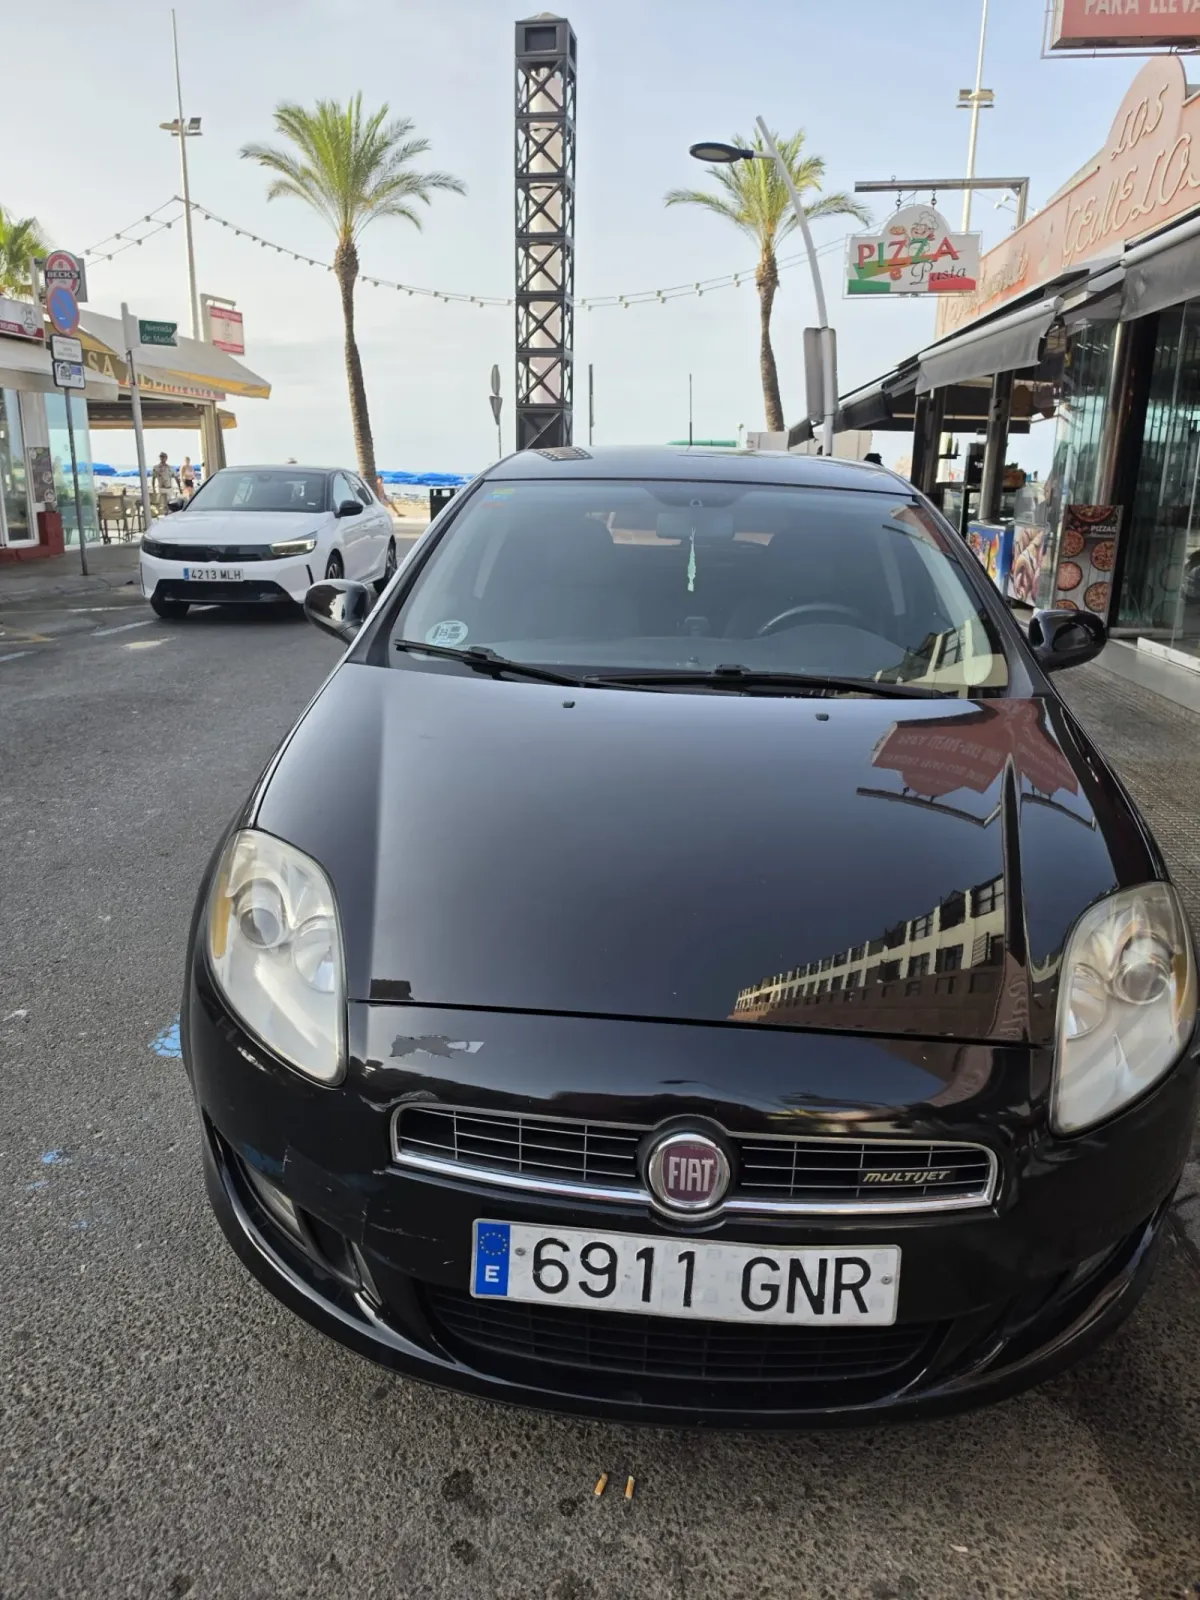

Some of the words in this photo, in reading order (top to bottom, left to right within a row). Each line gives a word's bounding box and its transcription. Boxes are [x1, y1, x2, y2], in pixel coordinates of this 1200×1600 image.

[1084, 0, 1140, 15] PARA
[857, 236, 961, 269] PIZZA
[909, 261, 967, 286] Pasta
[144, 323, 173, 333] Avenida
[1090, 524, 1116, 533] PIZZAS
[191, 569, 217, 580] 4213
[220, 569, 241, 580] MLH
[668, 1156, 714, 1192] FIAT
[862, 1170, 951, 1184] MULTIJET
[484, 1264, 500, 1283] E
[531, 1237, 696, 1308] 6911
[740, 1256, 872, 1316] GNR
